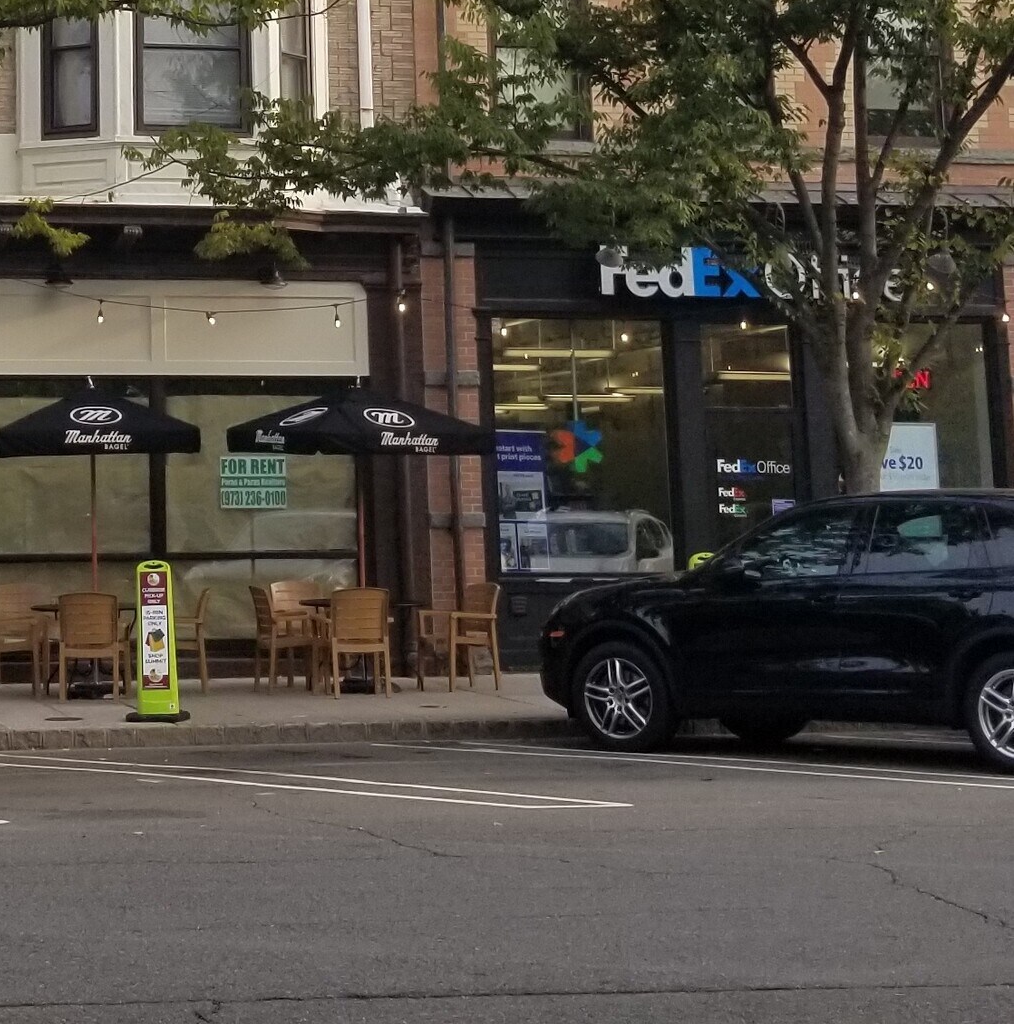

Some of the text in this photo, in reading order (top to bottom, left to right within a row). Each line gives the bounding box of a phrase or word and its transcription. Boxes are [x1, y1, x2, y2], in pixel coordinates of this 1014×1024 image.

[599, 245, 763, 298] FedEx
[64, 429, 133, 444] Manhattan
[381, 431, 439, 446] Manhattan
[519, 453, 542, 462] pieces
[899, 455, 923, 472] $20
[220, 458, 285, 475] FOR RENT
[717, 459, 790, 474] FedEx Office
[221, 490, 286, 506] (973) 236-0100
[718, 487, 745, 497] FedEx
[719, 503, 746, 514] FedEx
